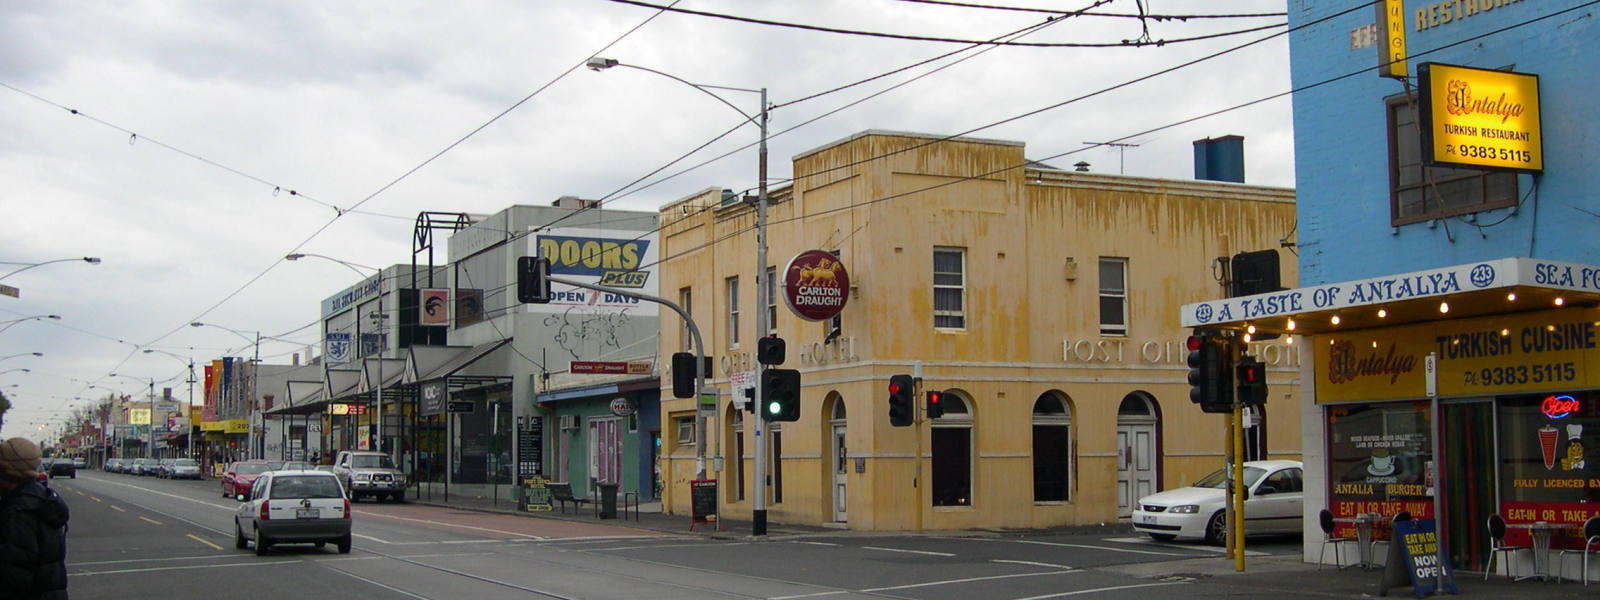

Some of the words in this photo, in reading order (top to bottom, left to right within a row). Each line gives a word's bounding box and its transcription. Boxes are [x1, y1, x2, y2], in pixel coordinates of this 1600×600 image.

[1447, 80, 1525, 124] Antalya
[1444, 124, 1478, 137] TURKISH
[1481, 128, 1530, 142] RESTAURANT
[1459, 144, 1497, 160] 9383
[1499, 148, 1531, 163] 5115
[540, 238, 638, 270] DOORS
[604, 273, 644, 285] PLUS
[1473, 266, 1492, 281] 233
[1535, 263, 1575, 287] SEA
[549, 291, 585, 302] OPEN
[586, 289, 601, 306] 7
[798, 286, 841, 296] CARLTON
[1217, 302, 1233, 322] A
[1241, 292, 1302, 318] TASTE
[1313, 287, 1340, 308] OF
[1348, 271, 1461, 304] ANTALYA
[796, 295, 843, 306] DRAUGHT
[1437, 331, 1512, 360] TURKISH
[1521, 322, 1596, 353] CUISINE
[1062, 338, 1125, 362] POST
[1329, 340, 1418, 385] Antalya
[1481, 365, 1529, 386] 9383
[1532, 362, 1576, 383] 5115
[1541, 395, 1580, 419] Open
[1334, 483, 1374, 495] ANTALIA
[1388, 483, 1423, 496] BURGER
[1513, 479, 1538, 488] FULLY
[1543, 479, 1585, 488] LICENCED
[1340, 502, 1354, 516] EAT
[1357, 502, 1365, 513] IN
[1367, 502, 1378, 513] OR
[1381, 502, 1401, 516] TAKE
[1405, 502, 1426, 517] AWAY
[1508, 509, 1536, 521] EAT-IN
[1542, 509, 1555, 521] OR
[1562, 509, 1588, 522] TAKE
[1404, 534, 1417, 544] EAT
[1407, 544, 1424, 555] TAKE
[1414, 555, 1439, 567] NOW
